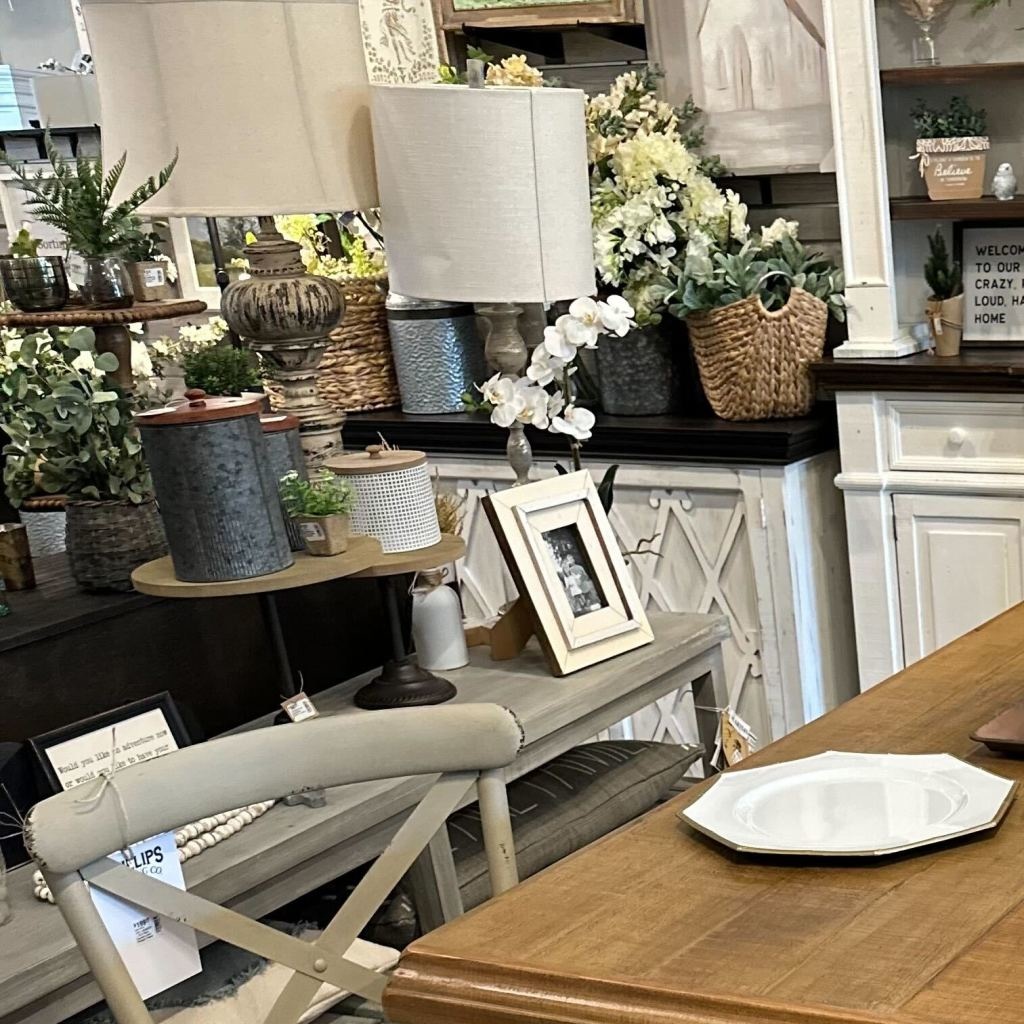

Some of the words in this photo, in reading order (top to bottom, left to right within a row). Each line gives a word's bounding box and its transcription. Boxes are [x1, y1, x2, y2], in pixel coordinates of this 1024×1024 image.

[934, 163, 973, 177] Believe
[976, 262, 991, 273] TO
[997, 262, 1020, 273] OUR
[975, 313, 1006, 324] HOME
[57, 762, 79, 774] Would
[81, 756, 94, 767] you
[95, 750, 110, 761] like
[122, 735, 155, 751] adventure
[156, 730, 167, 739] now
[75, 773, 95, 785] would
[128, 756, 136, 764] to
[138, 750, 154, 761] have
